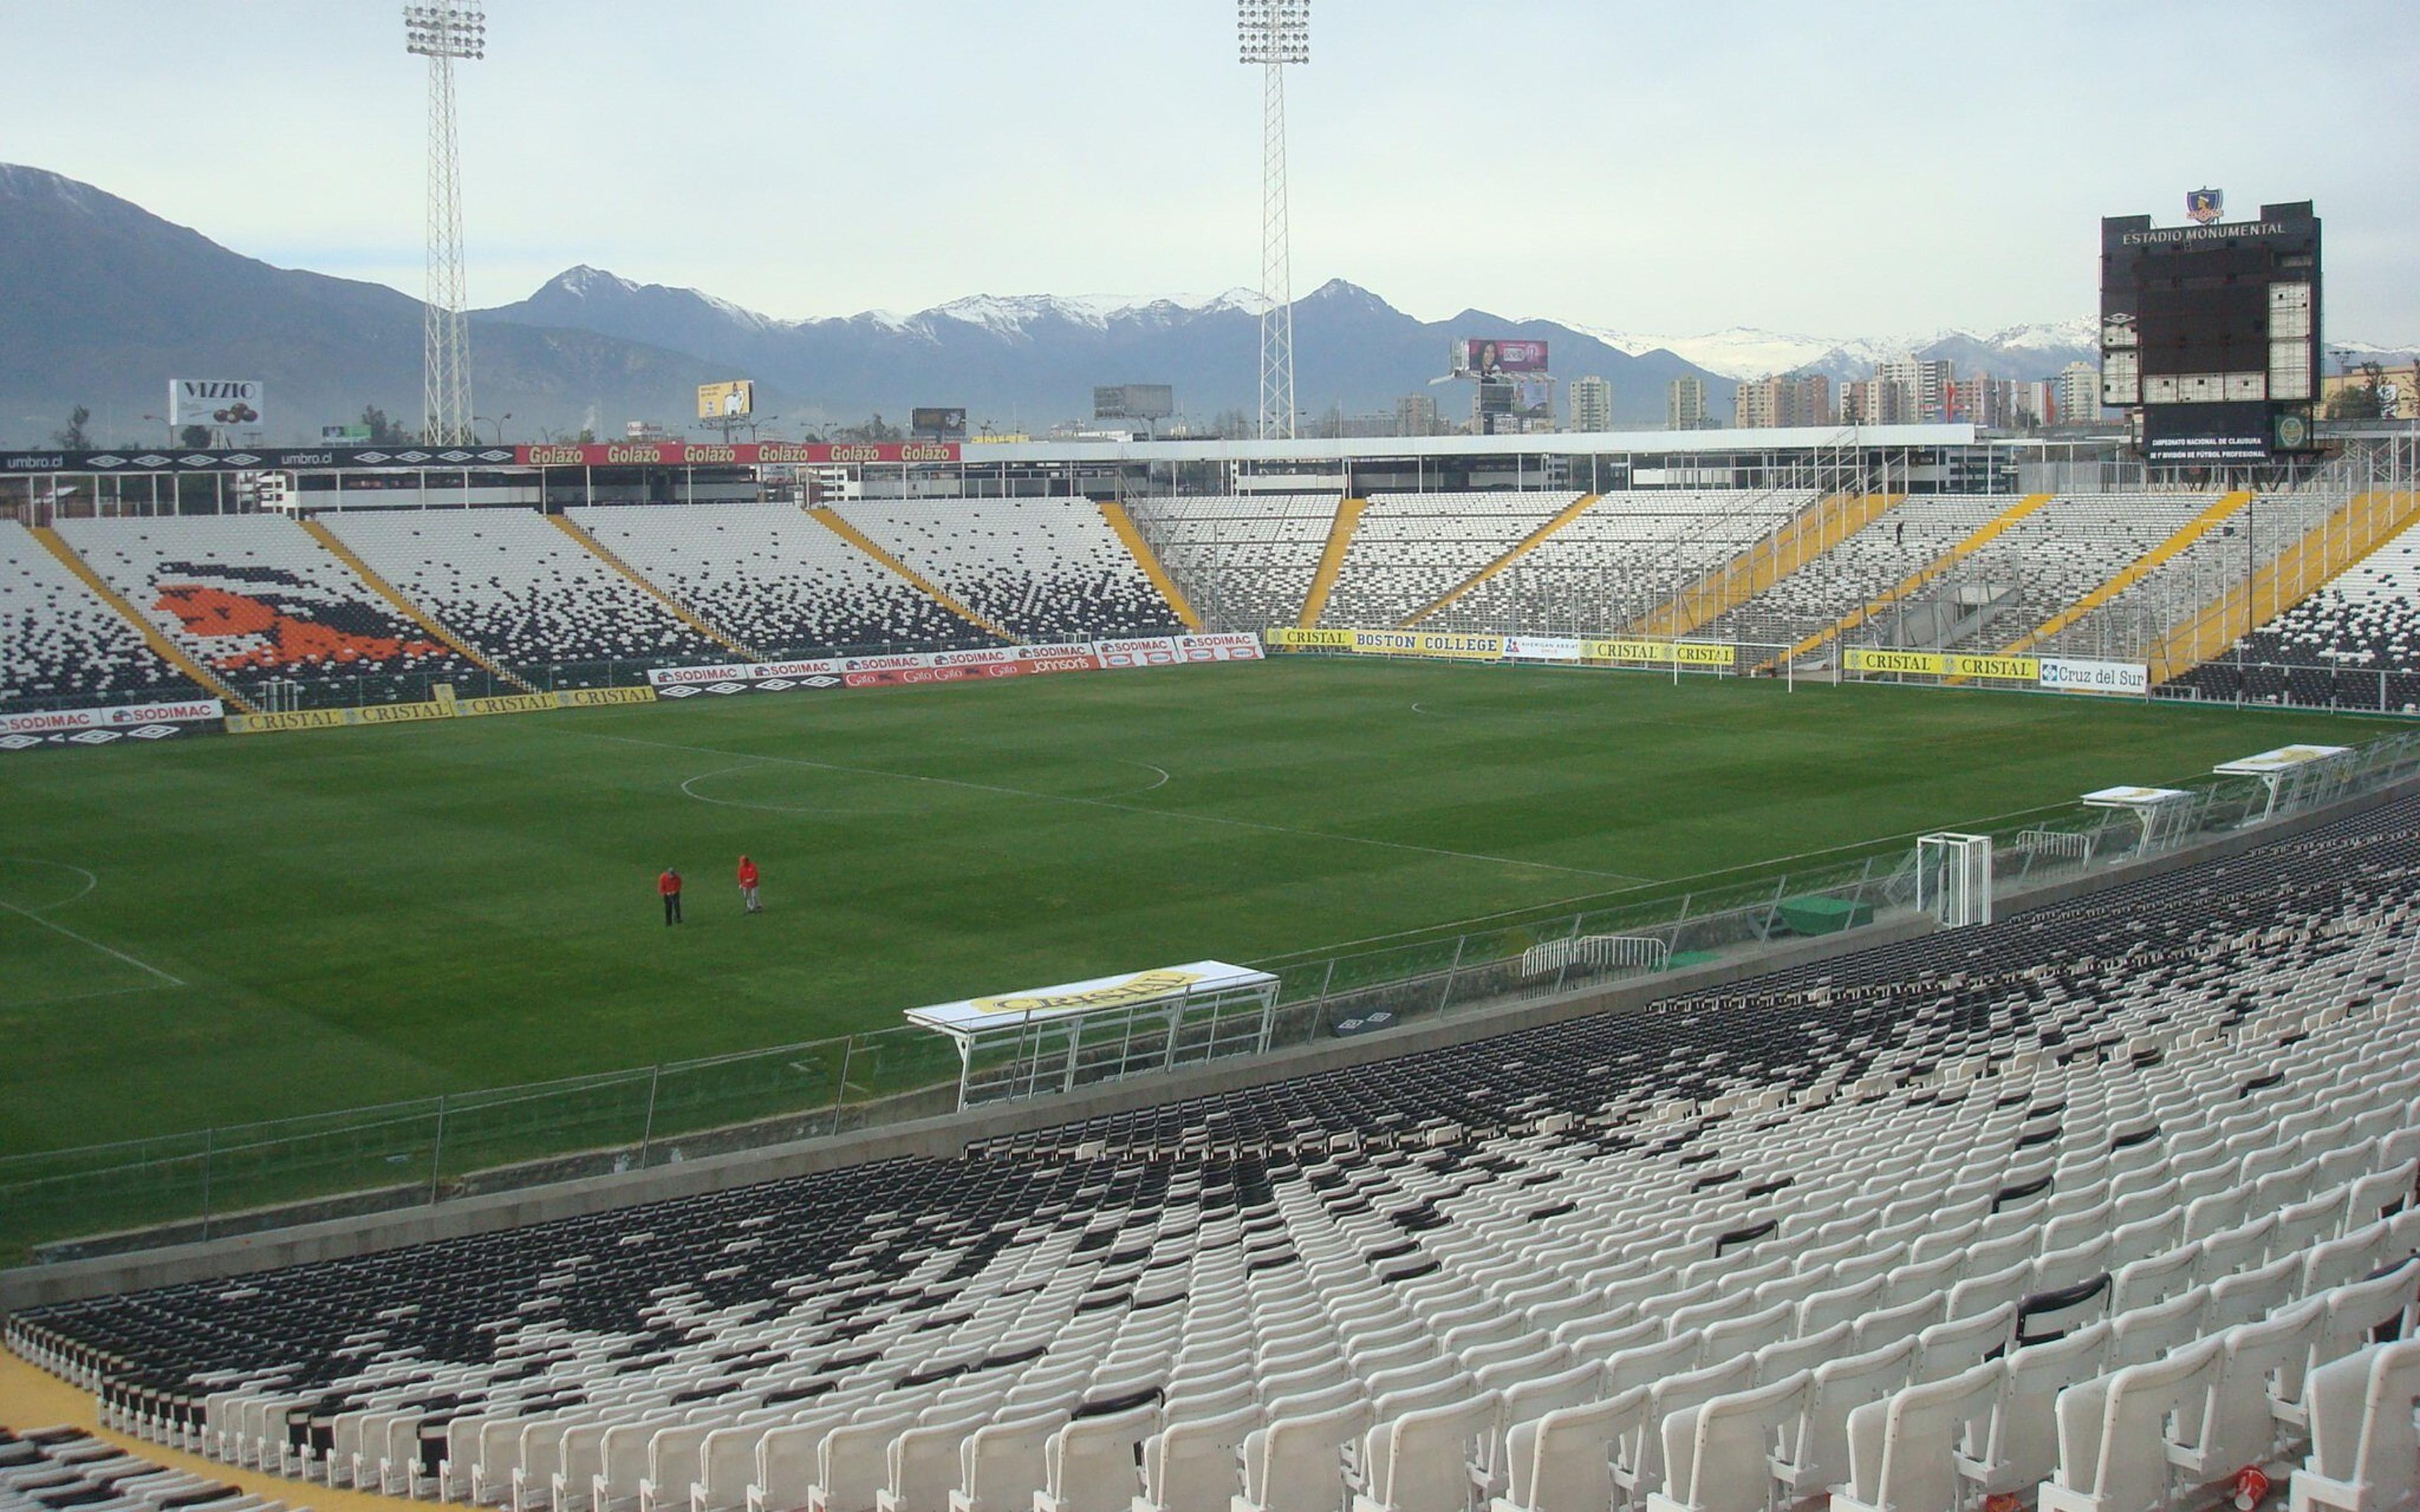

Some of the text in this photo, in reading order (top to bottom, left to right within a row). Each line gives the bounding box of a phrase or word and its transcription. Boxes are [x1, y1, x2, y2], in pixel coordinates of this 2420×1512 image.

[2123, 223, 2286, 244] ESTADIO MONUMENTAL
[185, 382, 255, 399] VIZZIO
[529, 446, 584, 464] Golazo
[608, 445, 660, 463] Golazo
[684, 445, 735, 462] Golazo
[758, 445, 808, 462] Golazo
[831, 444, 879, 461] Golazo
[901, 444, 950, 461] Golazo
[2196, 450, 2220, 458] FÚTBOL
[1197, 635, 1251, 647] SODIMAC
[1288, 631, 1345, 644] CRISTAL
[1357, 634, 1496, 651] BOSTON COLLEGE
[1032, 646, 1085, 657] SODIMAC
[1114, 640, 1168, 653] SODIMAC
[1598, 643, 1657, 659] CRISTAL
[861, 657, 919, 669] SODIMAC
[949, 651, 1005, 663] SODIMAC
[1867, 654, 1932, 671] CRISTAL
[674, 668, 737, 682] SODIMAC
[771, 663, 831, 676] SODIMAC
[1962, 659, 2031, 676] CRISTAL
[2059, 667, 2143, 686] Cruz del Sur
[473, 695, 555, 713] CRISTAL
[575, 688, 654, 705] CRISTAL
[134, 704, 212, 720] SODIMAC
[250, 711, 338, 730] CRISTAL
[362, 702, 449, 722] CRISTAL
[9, 713, 90, 731] SODIMAC
[994, 974, 1185, 1009] CRISTAL
